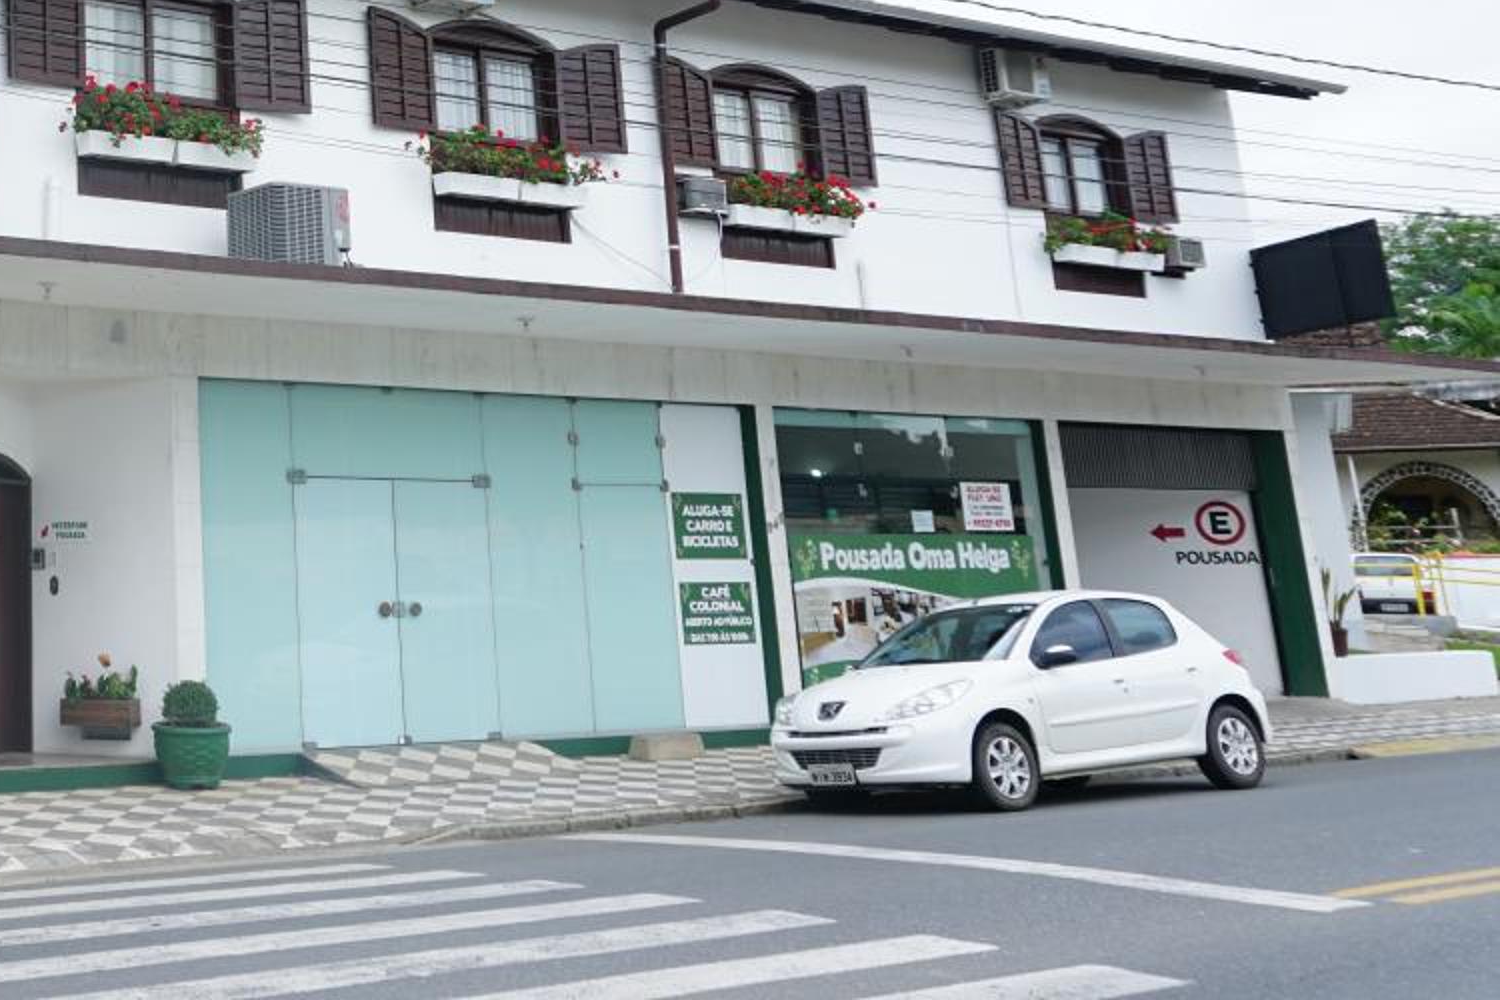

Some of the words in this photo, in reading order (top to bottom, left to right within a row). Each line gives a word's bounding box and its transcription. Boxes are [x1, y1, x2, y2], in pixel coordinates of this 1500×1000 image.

[681, 503, 735, 518] ALUGA-SE
[685, 519, 725, 533] CARRO
[1209, 511, 1233, 535] E
[682, 535, 740, 548] BICICLETAS
[819, 541, 907, 571] Pousada
[907, 541, 957, 570] Oma
[956, 541, 1011, 574] Helga
[1175, 551, 1261, 566] POUSADA
[700, 584, 731, 598] CAFÉ
[689, 600, 745, 613] COLONIAL
